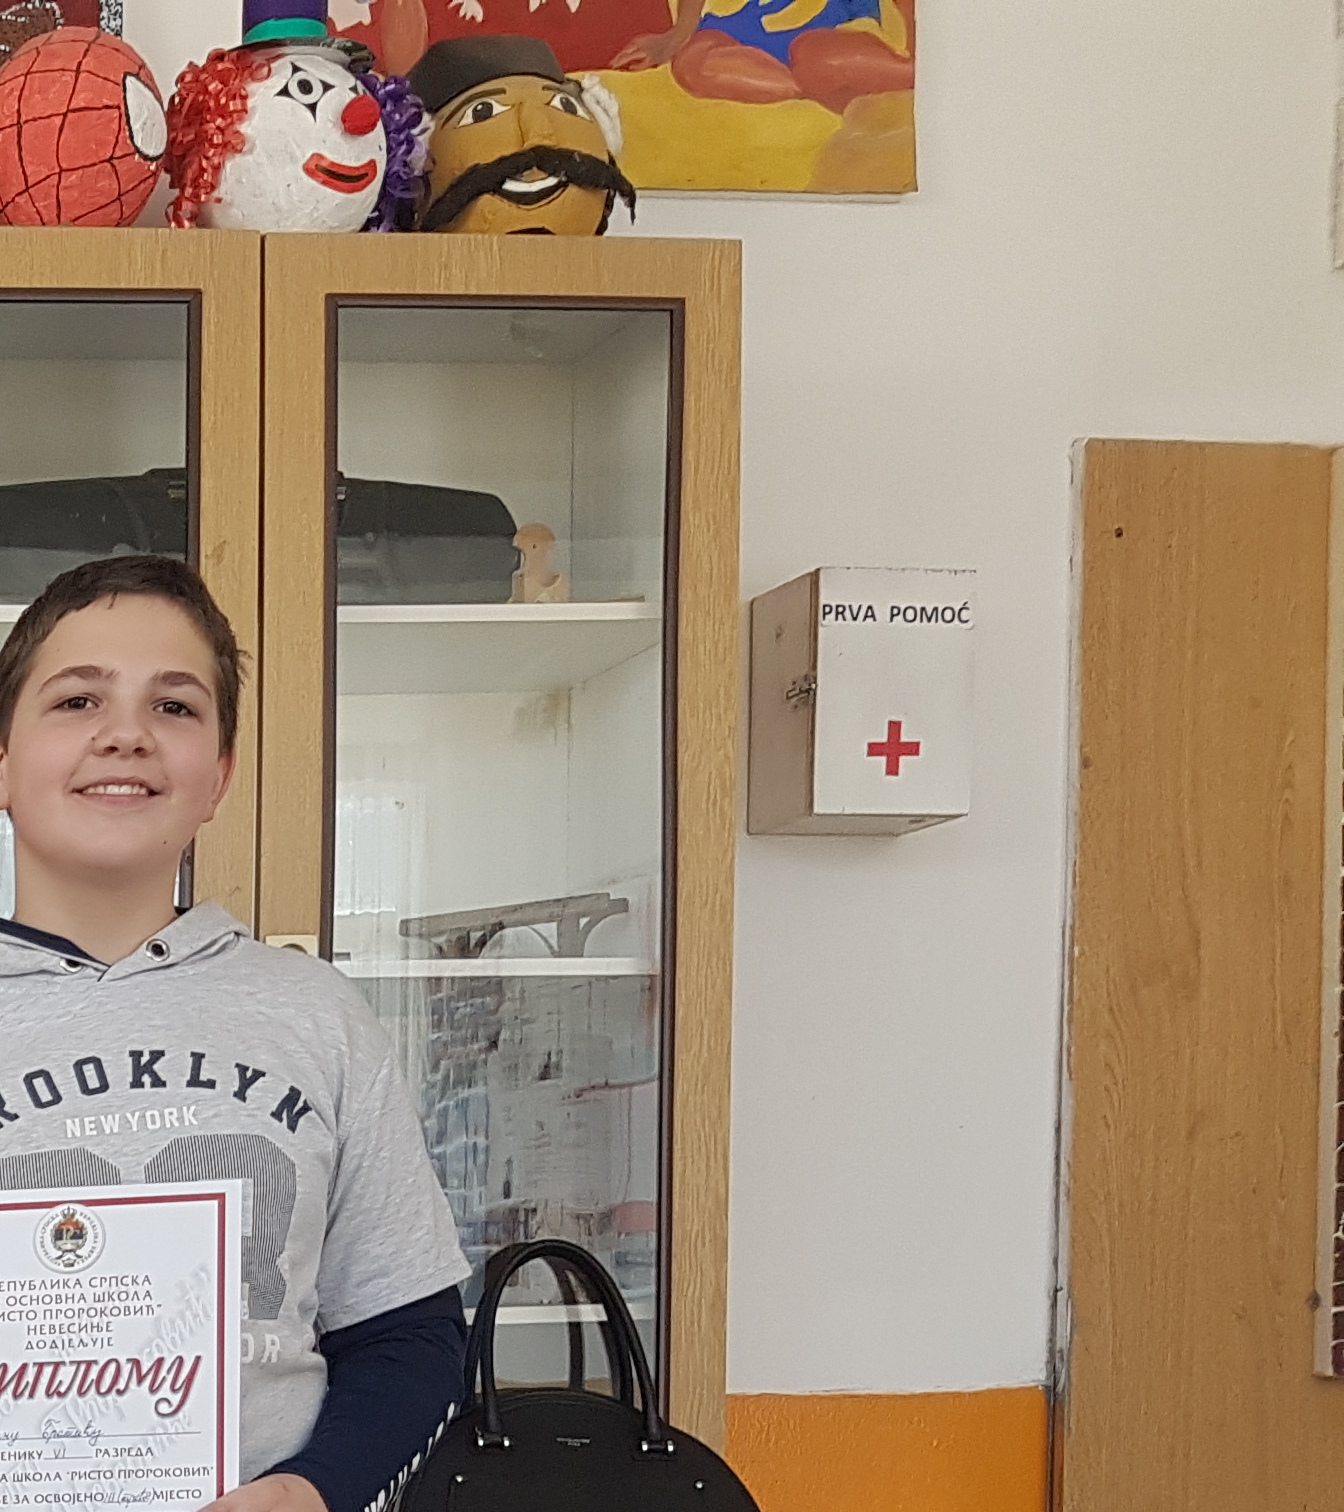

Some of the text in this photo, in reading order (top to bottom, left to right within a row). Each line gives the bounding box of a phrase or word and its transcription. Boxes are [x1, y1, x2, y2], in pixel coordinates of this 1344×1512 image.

[822, 601, 970, 624] PRVA POMOĆ
[88, 1274, 152, 1289] СРПСКА
[5, 1292, 87, 1307] ОСНОВНА
[93, 1289, 153, 1303] ШКОЛА
[26, 1320, 113, 1336] НЕВЕСИЊЕ
[24, 1336, 114, 1351] ДОДЈЕЉУЈЕ
[95, 1446, 154, 1458] РАЗРЕДА
[12, 1471, 63, 1483] ШКОЛА
[12, 1494, 30, 1505] ЗА
[33, 1491, 105, 1505] ОСВОЈЕНО
[151, 1488, 202, 1501] МЈЕСТО
